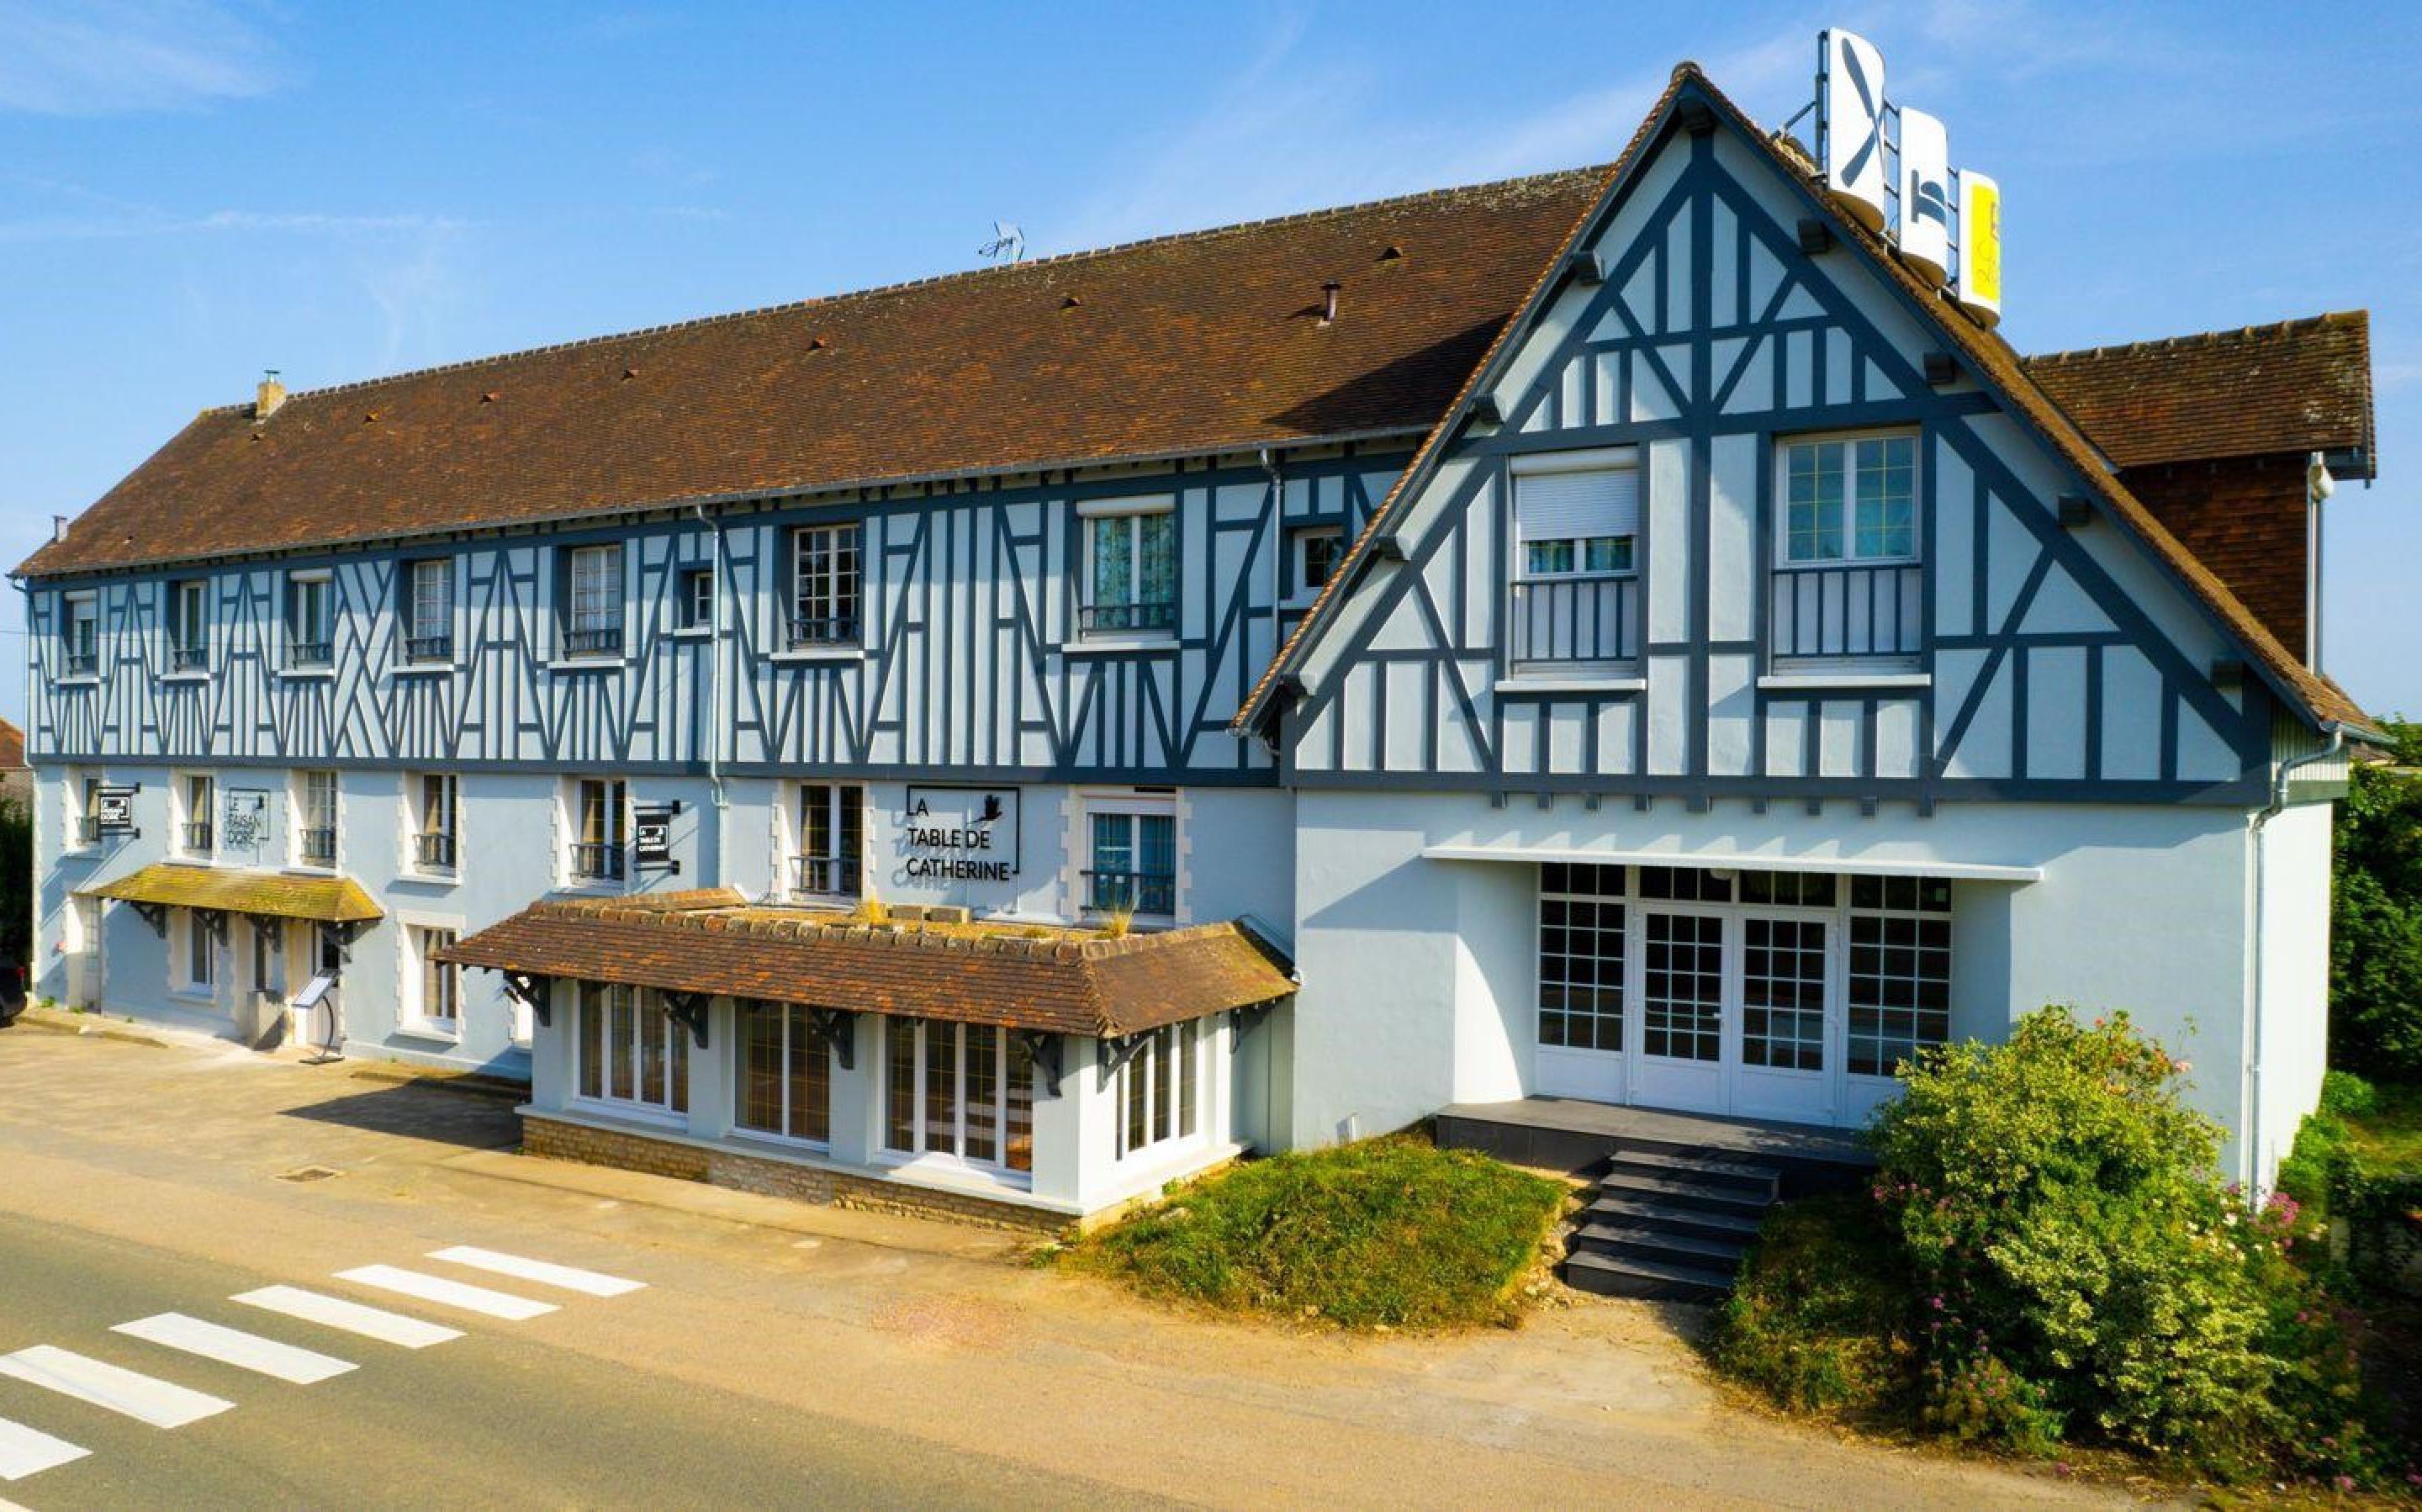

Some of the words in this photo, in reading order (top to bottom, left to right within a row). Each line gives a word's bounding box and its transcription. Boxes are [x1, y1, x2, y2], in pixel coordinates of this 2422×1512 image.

[908, 827, 960, 848] TABLE
[967, 831, 991, 849] DE
[907, 858, 1010, 880] CATHERINE
